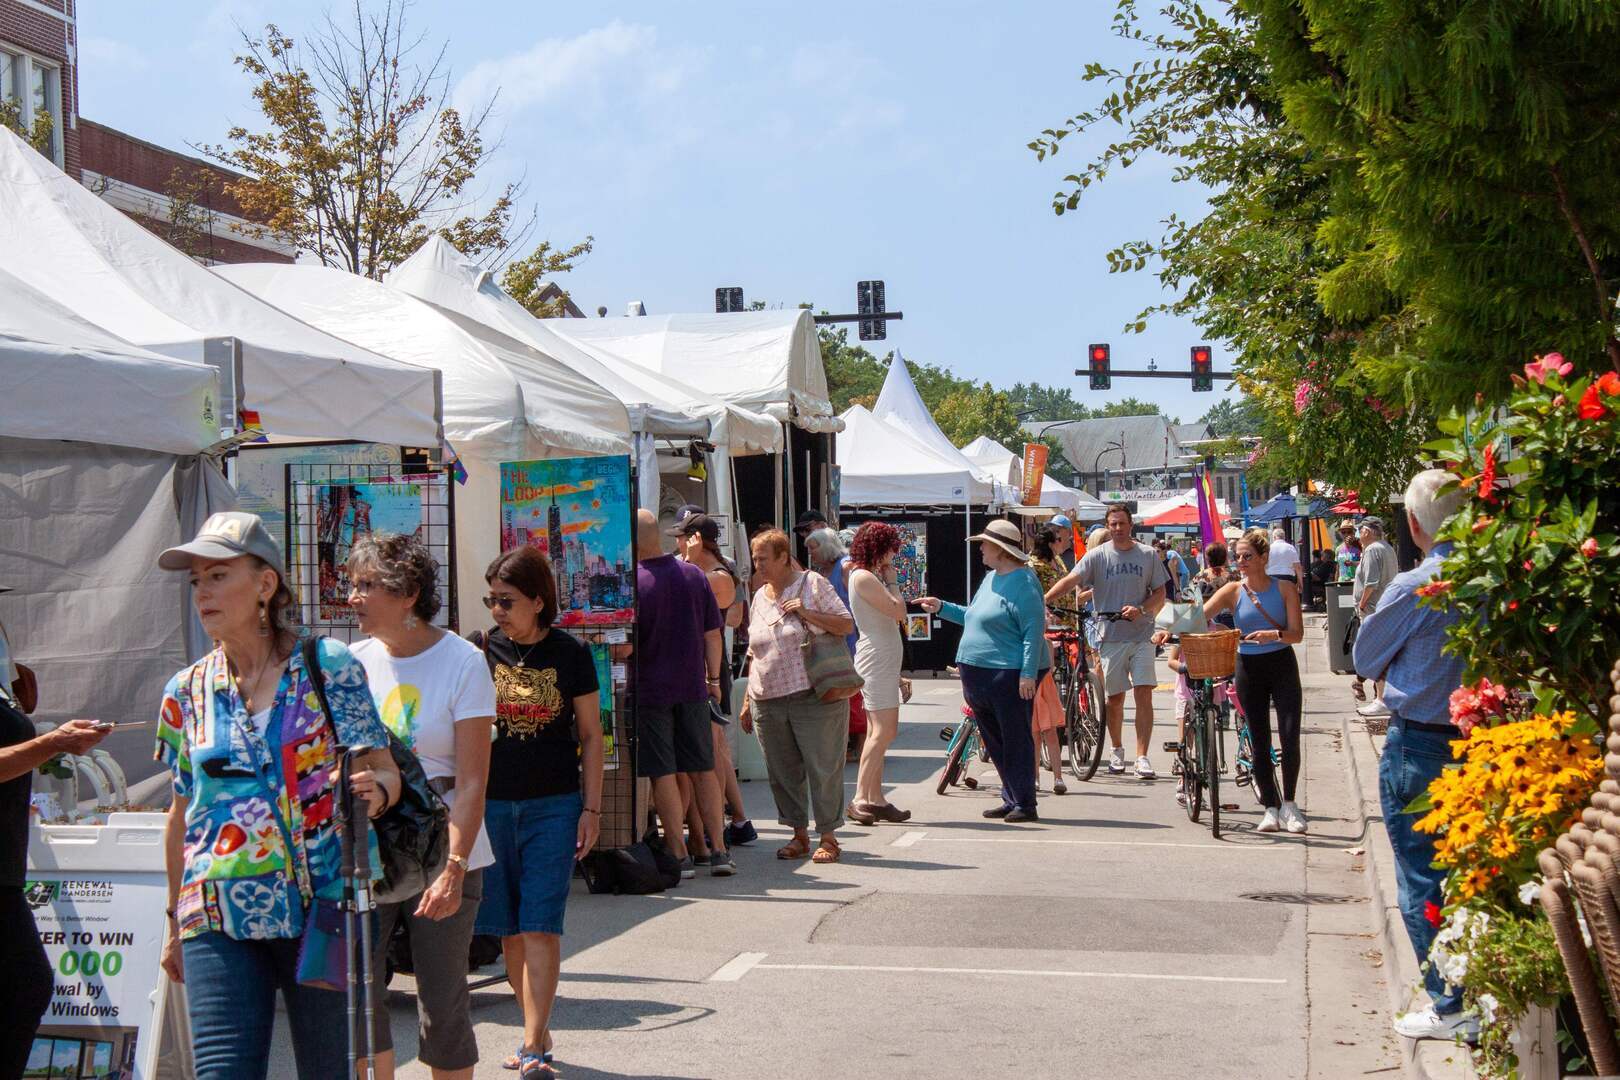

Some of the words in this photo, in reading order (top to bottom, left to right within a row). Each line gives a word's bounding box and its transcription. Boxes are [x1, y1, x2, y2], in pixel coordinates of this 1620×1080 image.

[1024, 448, 1037, 499] watercolor
[503, 484, 545, 503] LOOP
[1105, 563, 1143, 580] MIAMI
[62, 880, 113, 889] RENEWAL
[72, 932, 93, 945] TO
[99, 932, 134, 946] WIN
[86, 982, 104, 999] by
[51, 1002, 119, 1017] Windows
